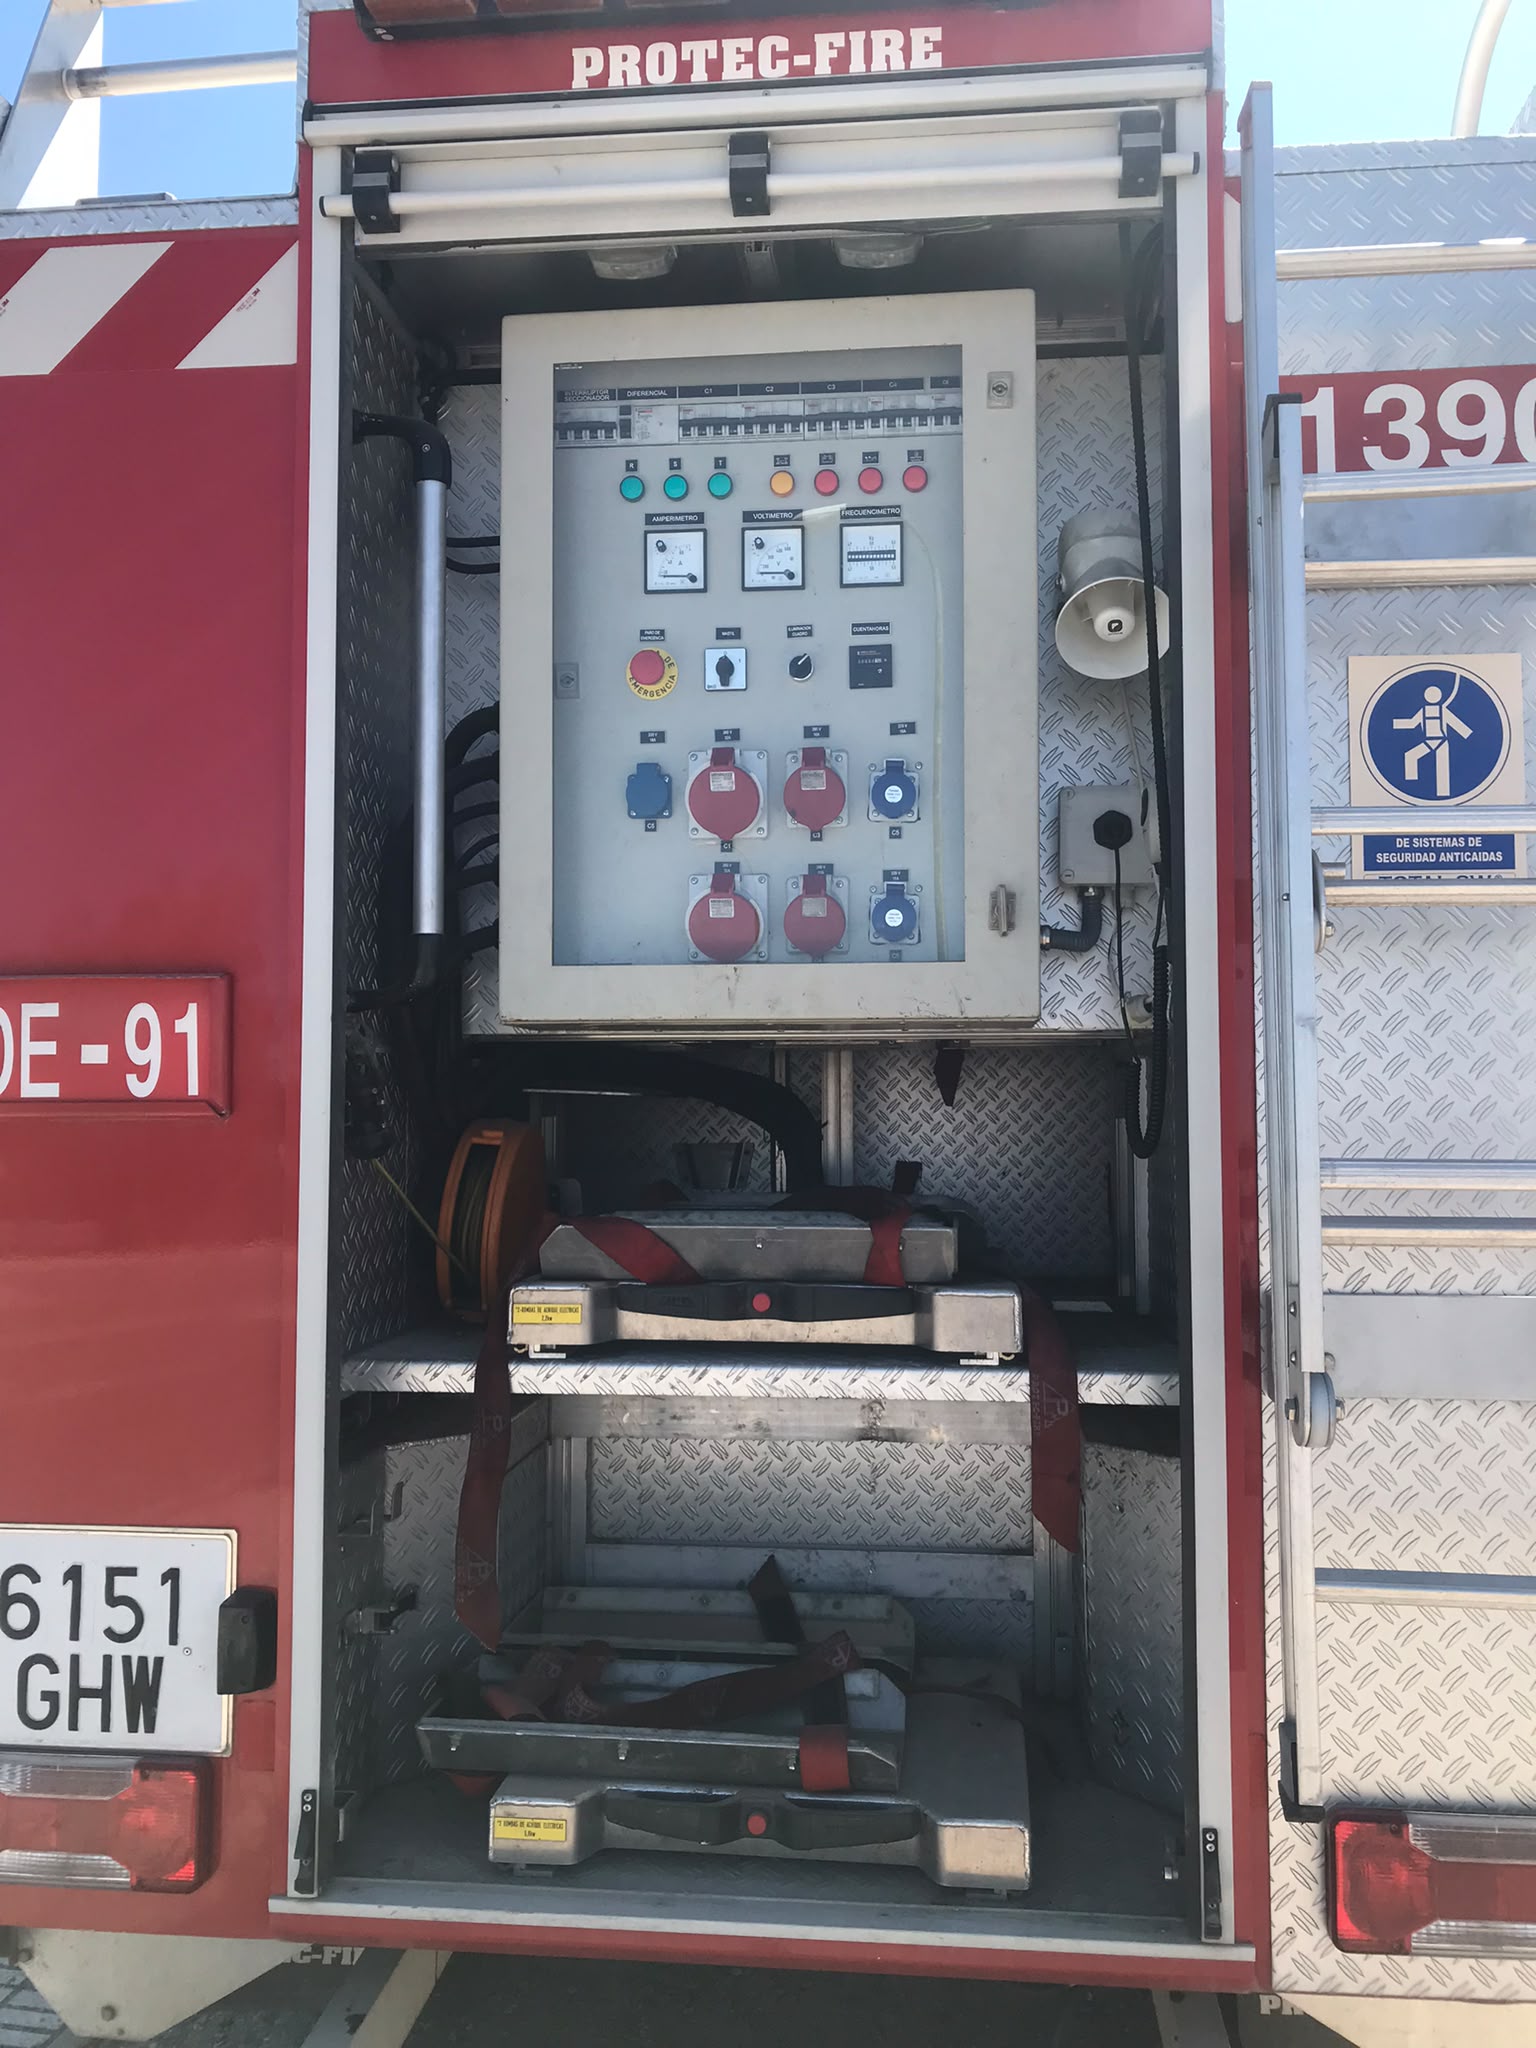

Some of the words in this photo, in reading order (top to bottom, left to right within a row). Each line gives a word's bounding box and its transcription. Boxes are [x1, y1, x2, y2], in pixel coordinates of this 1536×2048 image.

[572, 26, 942, 89] PROTEC-FIRE
[826, 383, 836, 391] C3
[564, 389, 609, 397] INTERRUPTOR
[626, 389, 668, 398] DIFERENCIAL
[752, 512, 794, 520] VOLTIMETRO
[841, 507, 901, 517] FRECUENCIMETRO
[651, 515, 698, 523] AMPERIMETRO
[852, 625, 889, 633] CUENTAHORAS
[664, 656, 676, 669] DE
[628, 674, 677, 698] EMERGENCIA
[1396, 837, 1410, 848] DE
[1412, 837, 1465, 848] SISTEMAS
[1468, 836, 1482, 847] DE
[1376, 852, 1436, 863] SEGURIDAD
[1439, 851, 1503, 863] ANTICAIDAS
[0, 1563, 181, 1646] 6151
[17, 1653, 164, 1734] GHW
